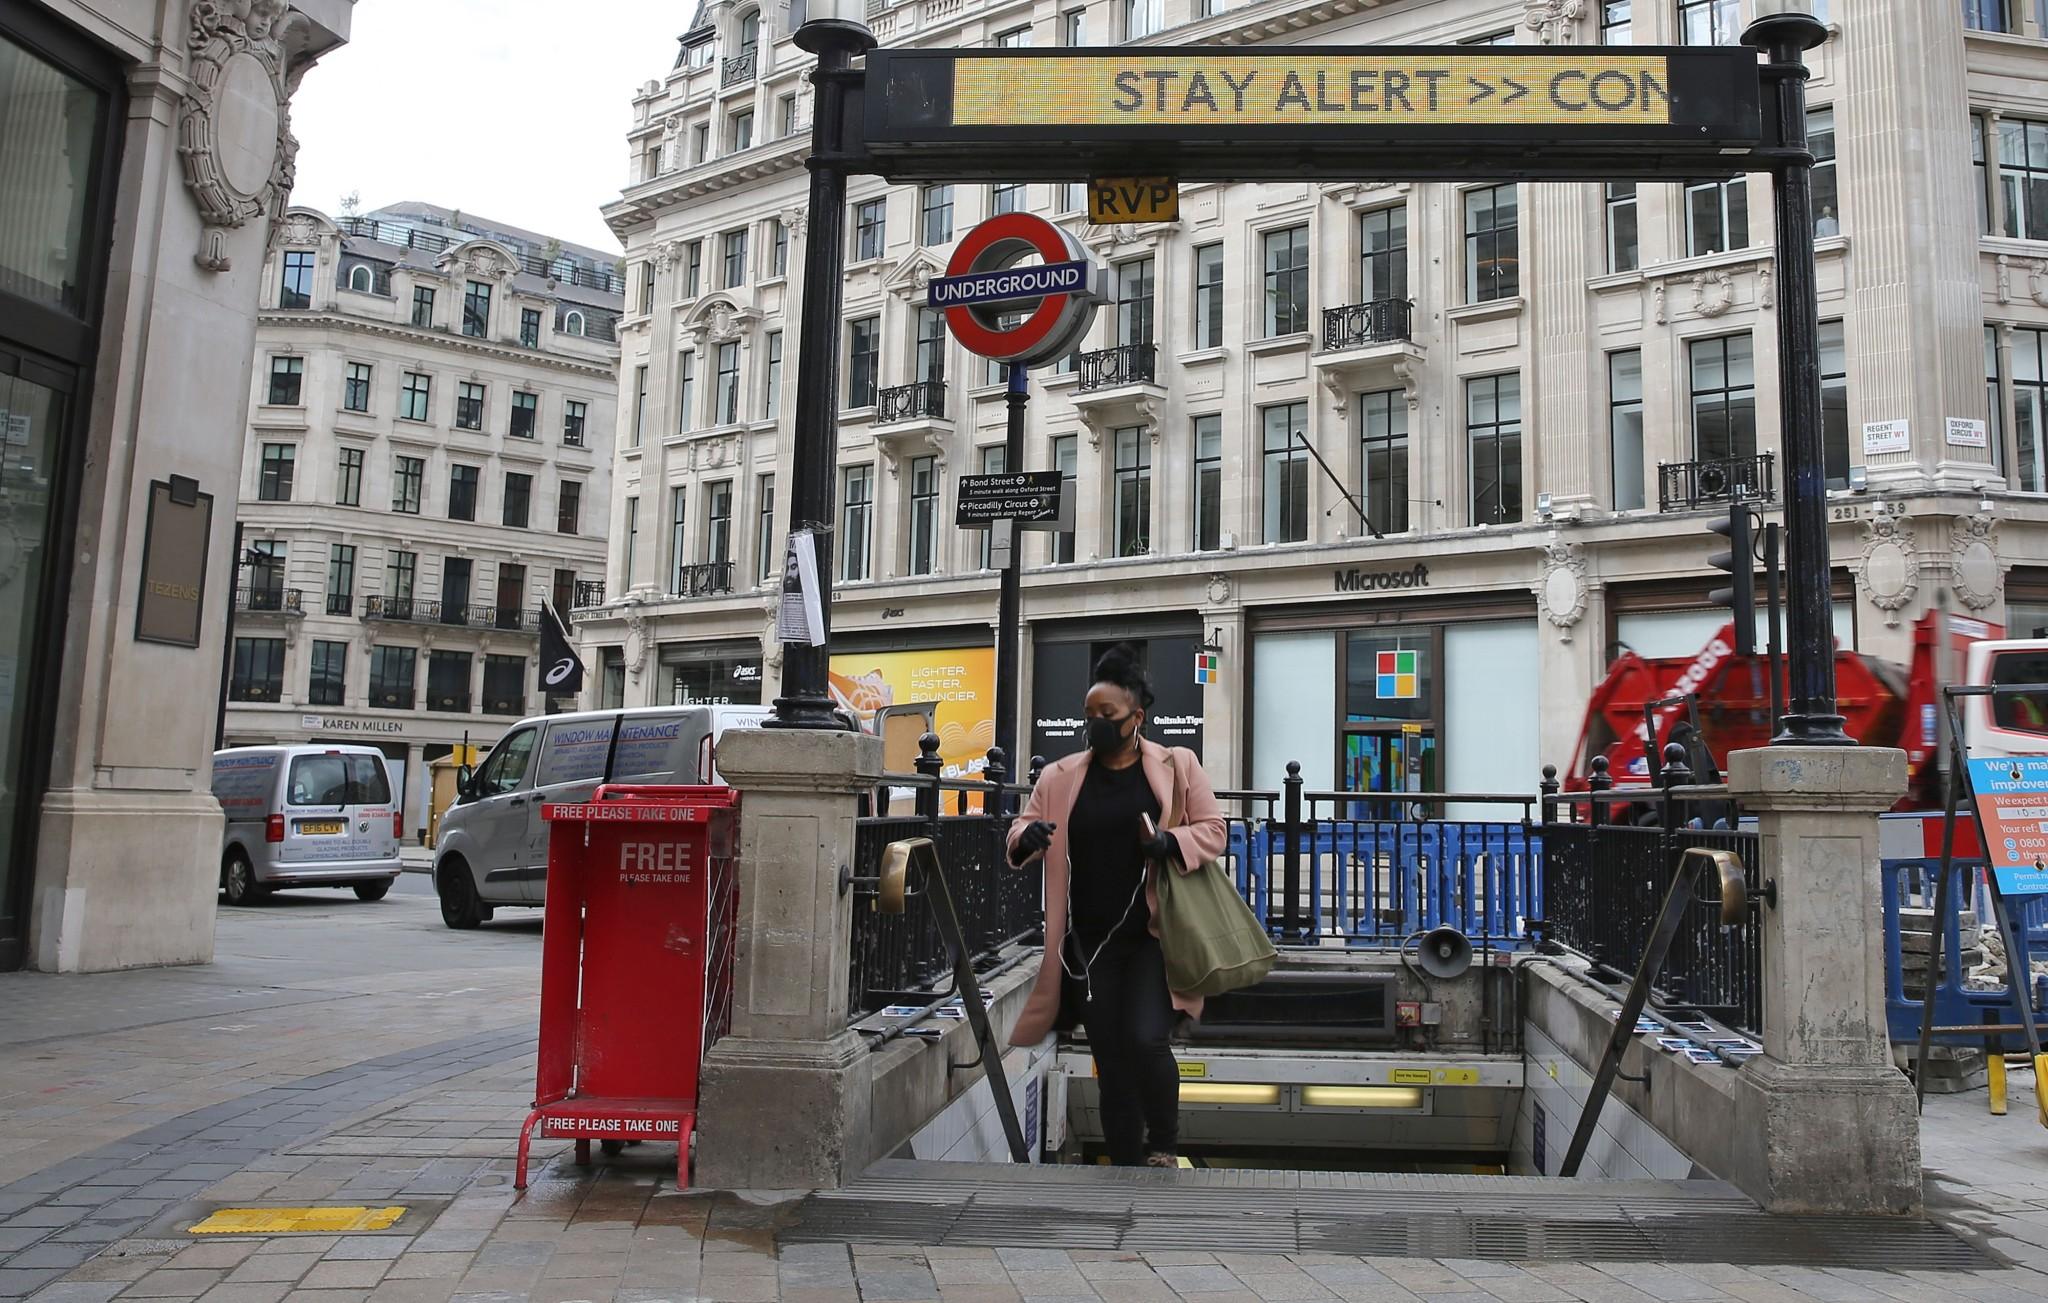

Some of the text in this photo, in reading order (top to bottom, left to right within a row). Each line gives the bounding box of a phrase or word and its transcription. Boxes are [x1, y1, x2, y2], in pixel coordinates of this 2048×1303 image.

[1112, 70, 1257, 113] STAY
[1274, 69, 1451, 113] ALERT
[1097, 184, 1171, 216] RVP
[934, 268, 1079, 302] UNDERGROUND
[1866, 423, 1893, 433] REGENT
[1950, 420, 1974, 429] OXFORD
[1867, 431, 1905, 441] STREET W1
[1950, 428, 1983, 439] CIRCUS W1
[969, 477, 1015, 488] Bond Street
[967, 500, 1028, 511] Piccadilly Circus
[1834, 506, 1859, 520] 251
[1334, 562, 1429, 592] Microsoft
[911, 666, 967, 678] LIGHTER.
[911, 679, 961, 689] FASTER.
[911, 691, 977, 703] BOUNCIER.
[323, 719, 360, 730] KAREN
[362, 721, 403, 732] MILLEN
[736, 717, 763, 728] WIN
[1185, 715, 1204, 726] Tige
[553, 724, 680, 744] WINDOW MANTENANCE
[1994, 797, 2011, 806] We
[2011, 796, 2042, 807] expect
[553, 806, 695, 821] FREE PLEASE TAKE ONE
[2000, 824, 2038, 834] Your ref:
[2019, 838, 2046, 848] 0800
[619, 842, 692, 871] FREE
[619, 874, 691, 883] PLEASE TAKE ONE
[547, 1117, 679, 1132] FREE PLEASE TAKE ONE
